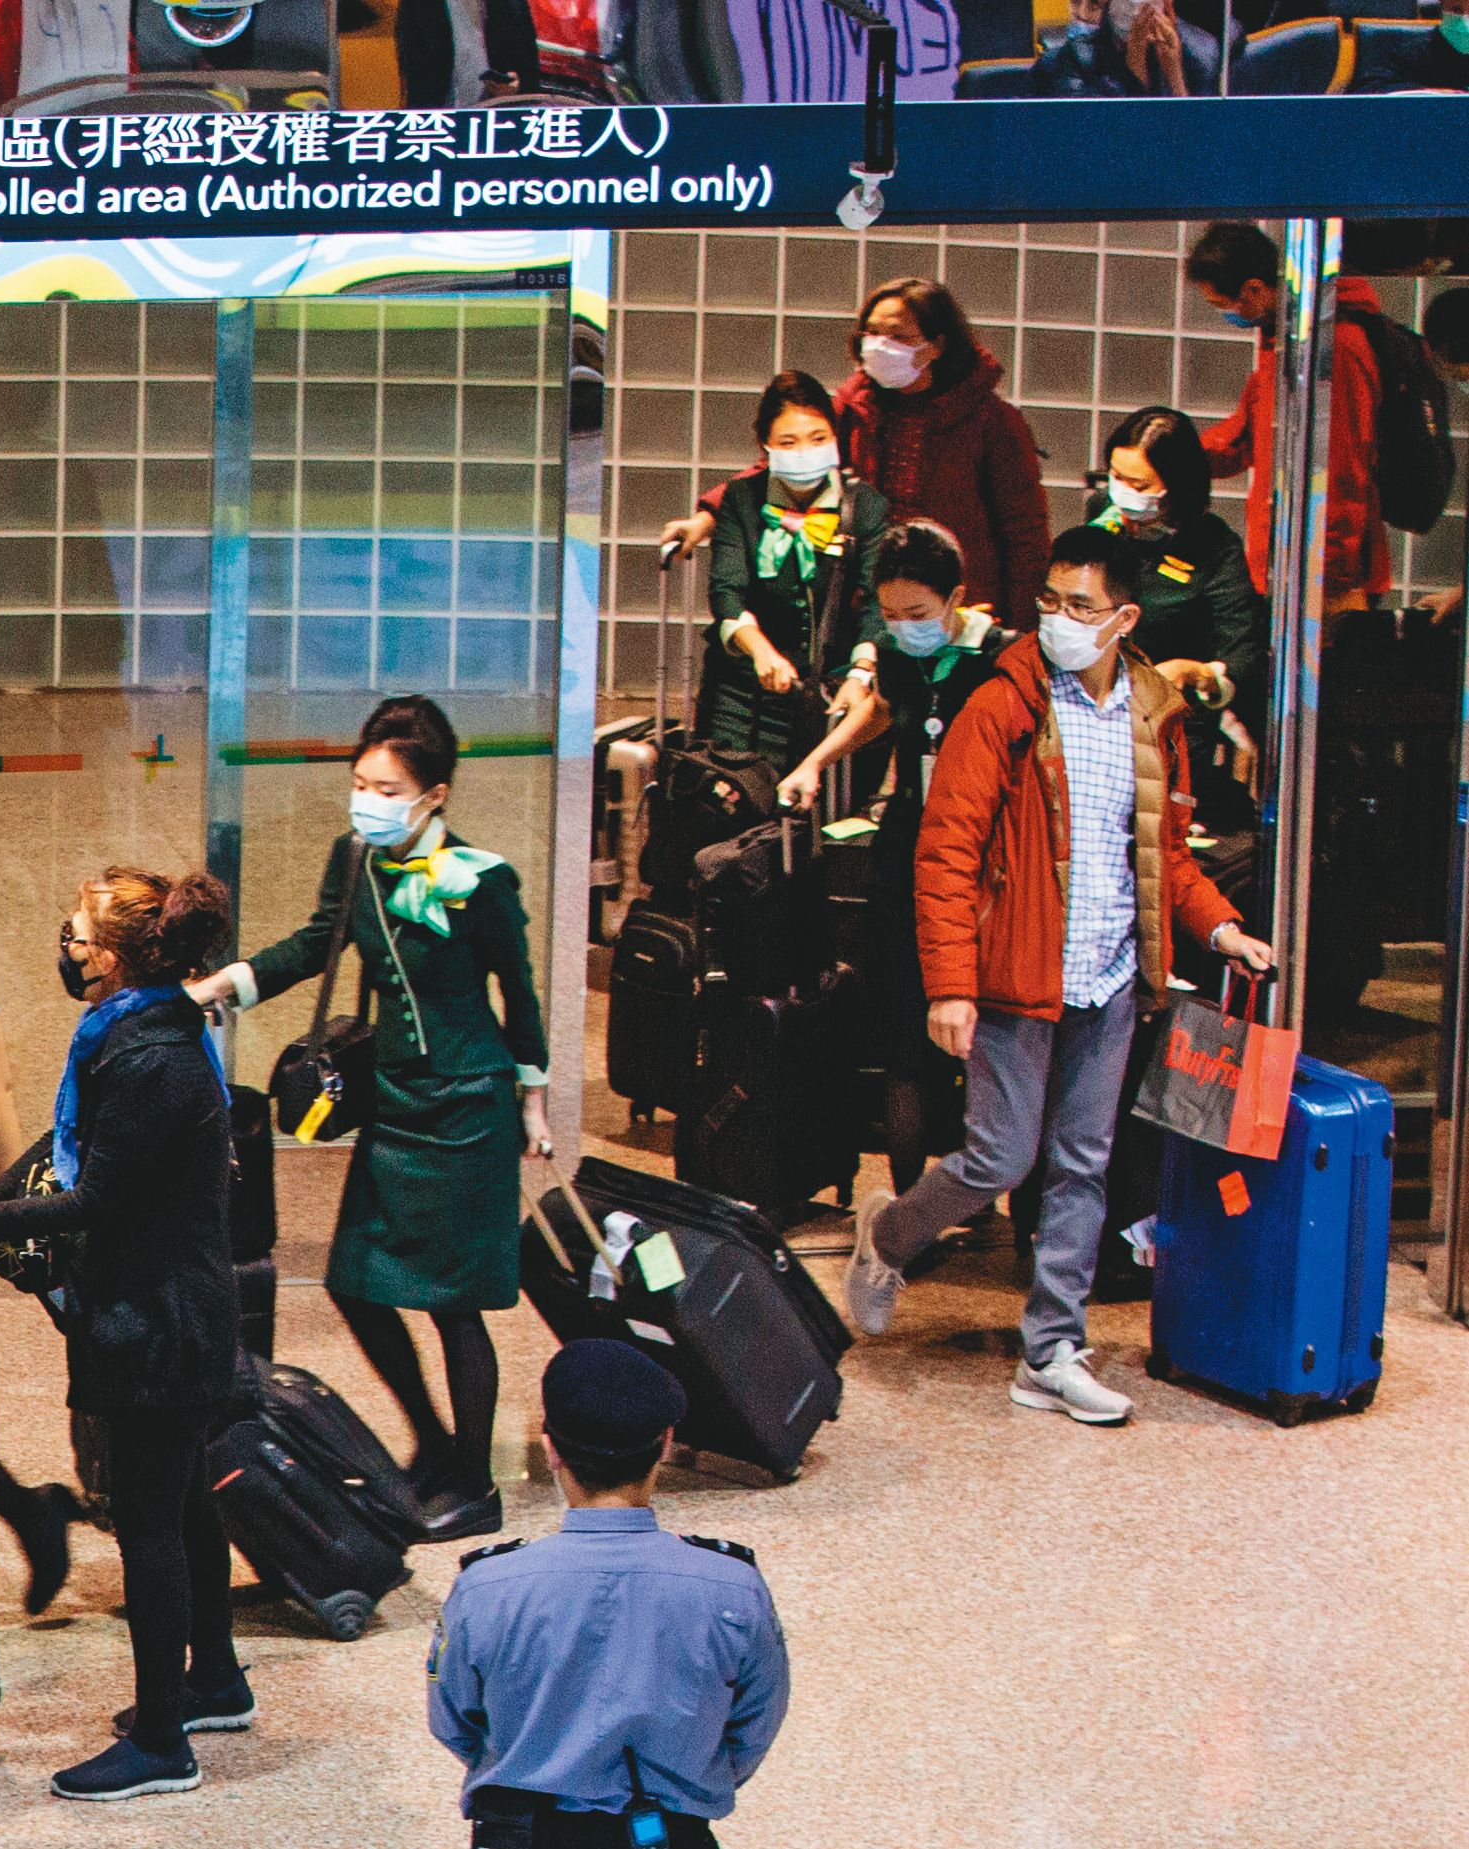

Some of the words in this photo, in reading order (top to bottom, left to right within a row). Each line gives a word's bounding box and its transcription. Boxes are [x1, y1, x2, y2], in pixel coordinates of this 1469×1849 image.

[97, 187, 187, 214] area
[197, 169, 442, 218] (Authorized
[453, 165, 660, 217] personnel
[670, 163, 773, 212] only)
